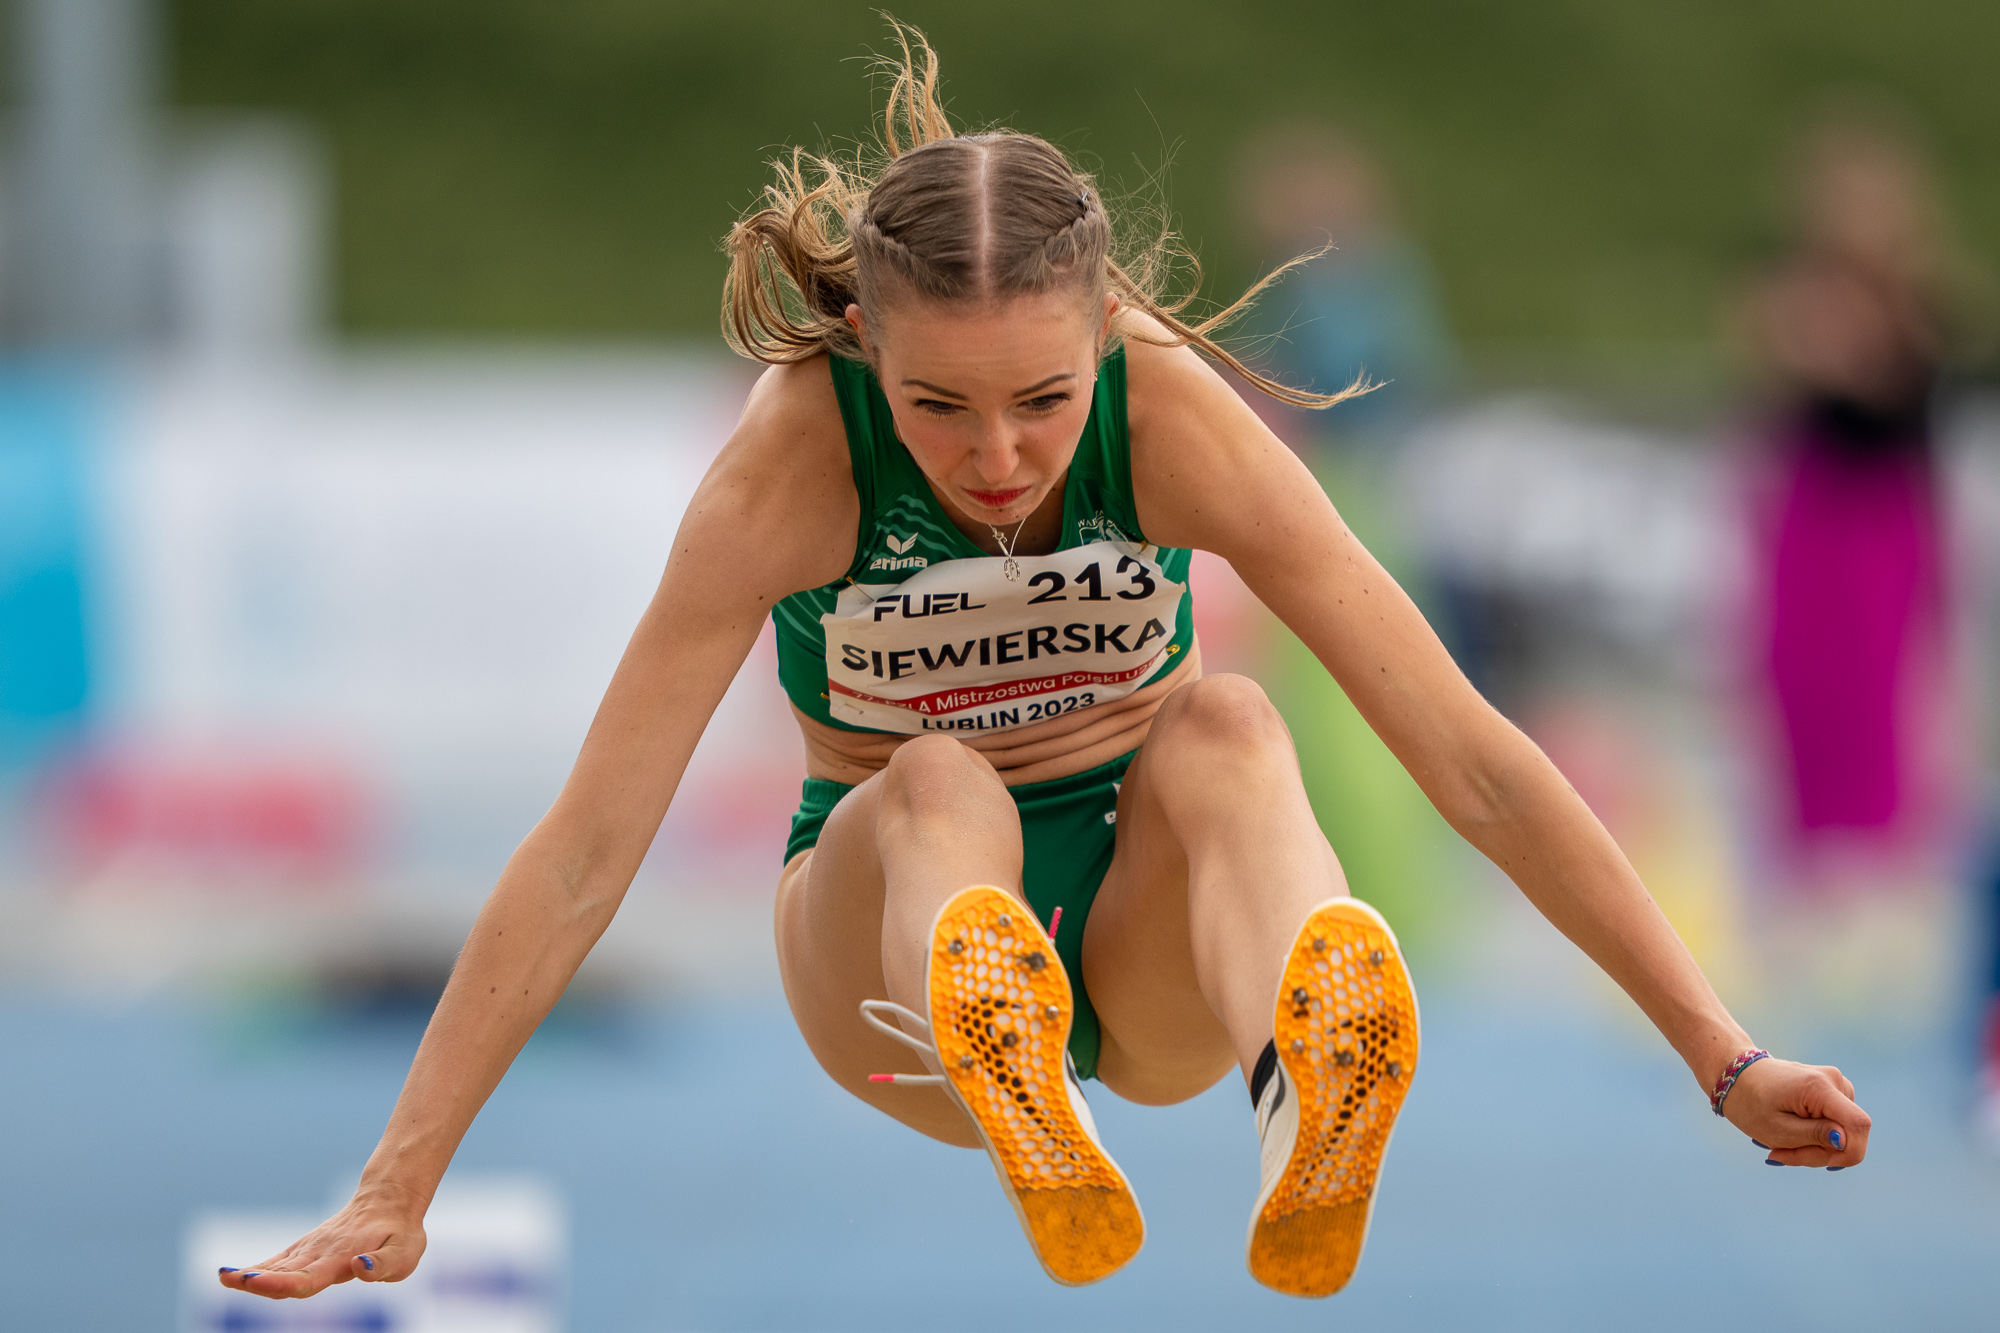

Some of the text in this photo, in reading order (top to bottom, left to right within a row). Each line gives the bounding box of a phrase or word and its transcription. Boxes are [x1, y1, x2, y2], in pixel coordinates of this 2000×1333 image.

[869, 555, 928, 571] erima
[1027, 555, 1157, 605] 213
[873, 592, 987, 622] FUEL
[841, 617, 1168, 681] SIEWIERSKA
[921, 692, 1096, 731] LUBLIN 2023
[936, 678, 1056, 712] Mistrzostwa
[1062, 673, 1119, 686] Polski
